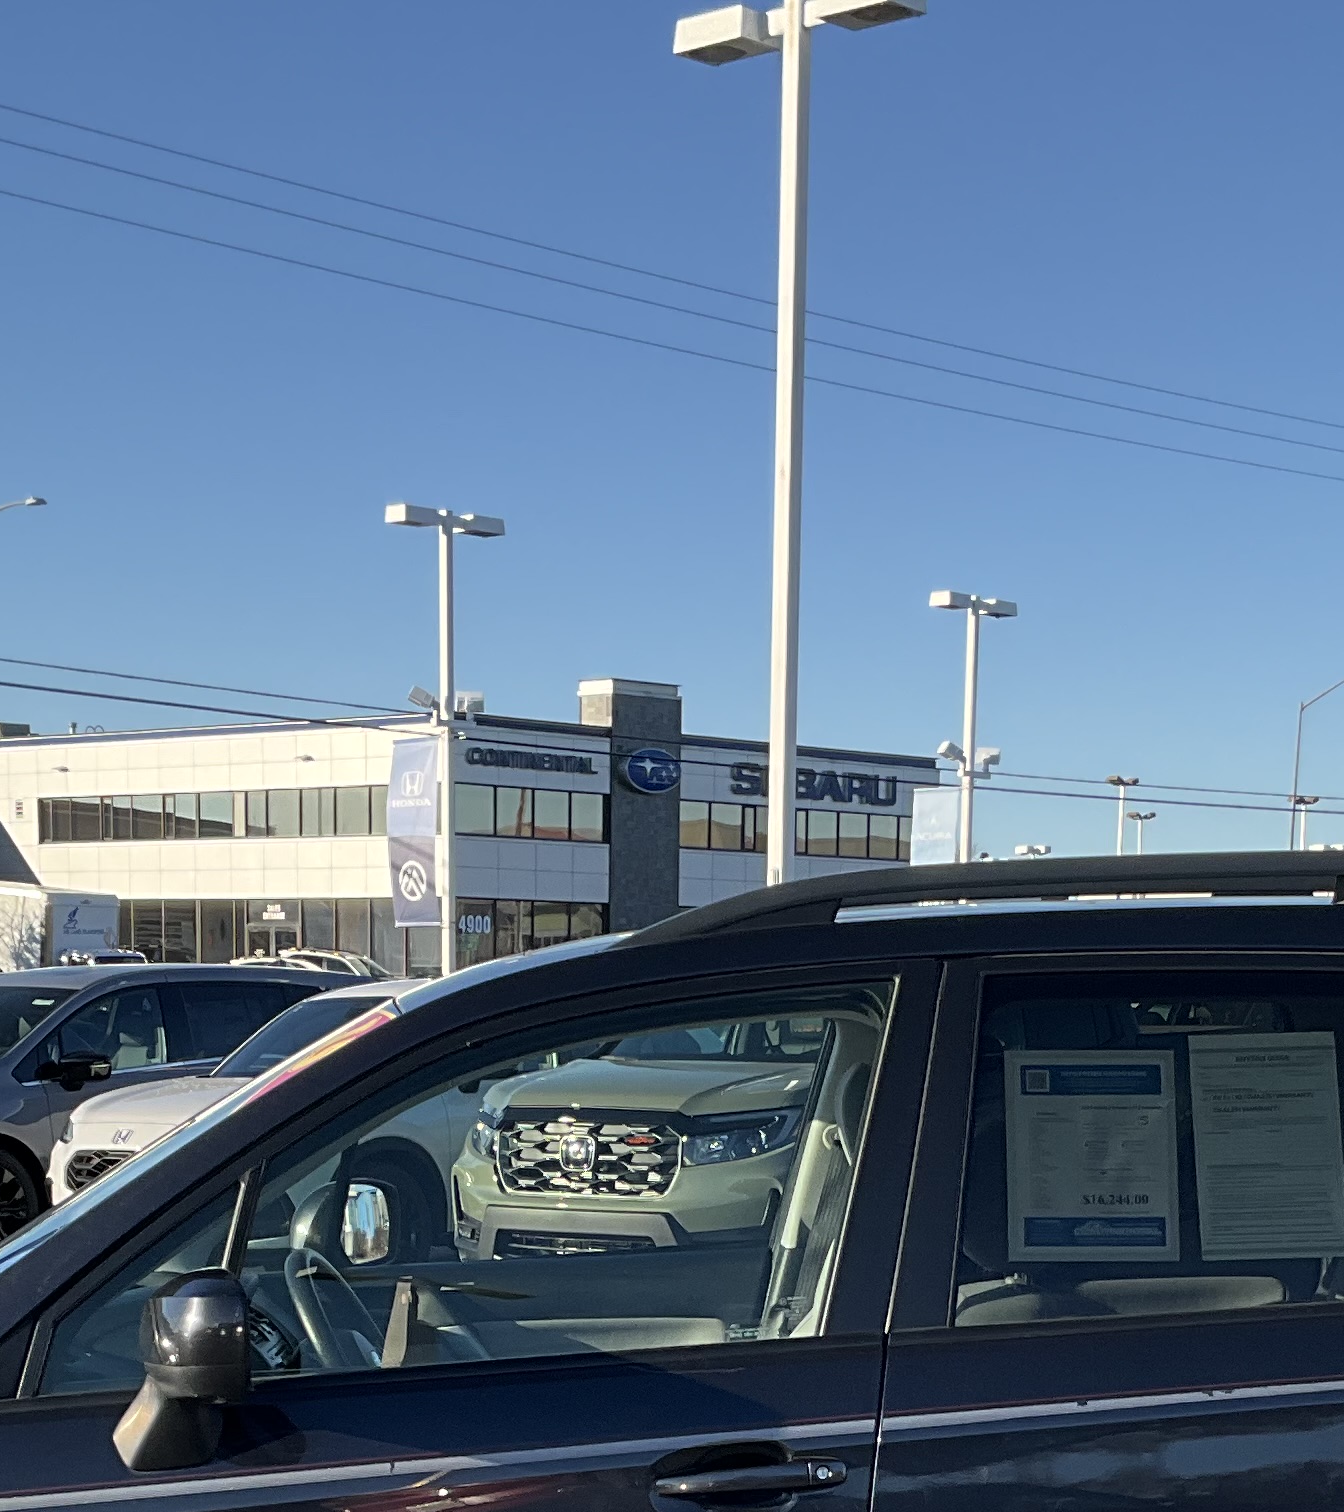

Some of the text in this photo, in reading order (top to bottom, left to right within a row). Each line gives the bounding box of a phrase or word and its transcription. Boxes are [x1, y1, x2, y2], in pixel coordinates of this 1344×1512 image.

[730, 762, 897, 806] SBARU
[391, 798, 432, 809] HONDA
[458, 914, 491, 934] 4900
